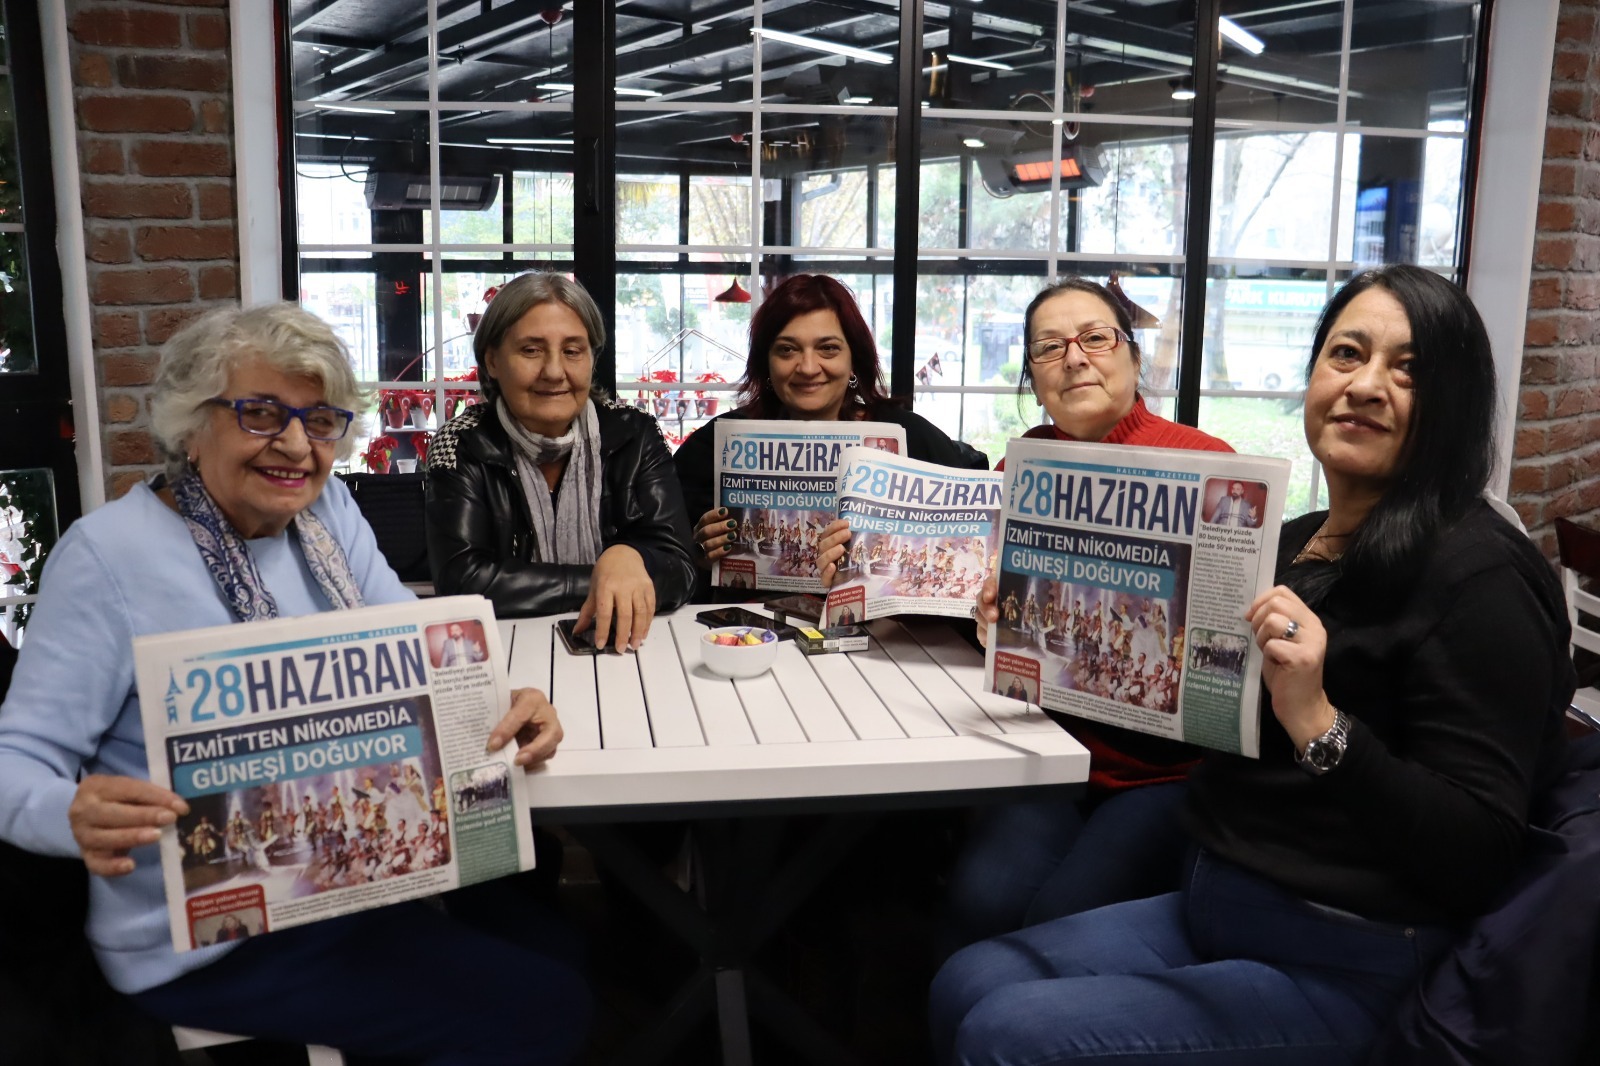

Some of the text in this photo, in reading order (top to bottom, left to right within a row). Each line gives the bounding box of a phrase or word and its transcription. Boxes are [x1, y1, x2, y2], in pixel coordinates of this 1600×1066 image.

[731, 440, 860, 472] 28HAZİRA
[723, 476, 837, 492] İZMİT'TEN NİKOMEDİ
[1117, 467, 1146, 475] HALKIN
[728, 491, 773, 508] GÜNEŞİ
[839, 501, 988, 522] İZMİT'TEN NİKOMEDİA
[843, 515, 980, 535] GÜNEŞİ DOĞUYOR
[1006, 524, 1170, 566] İZMİT'TEN NİKOMEDİA
[1011, 547, 1160, 592] GÜNEŞİ DOĞUYOR
[173, 727, 287, 763] İZMİT'TEN
[293, 704, 412, 743] NİKOMEDİA
[192, 733, 407, 789] GÜNEŞİ DOĞUYOR
